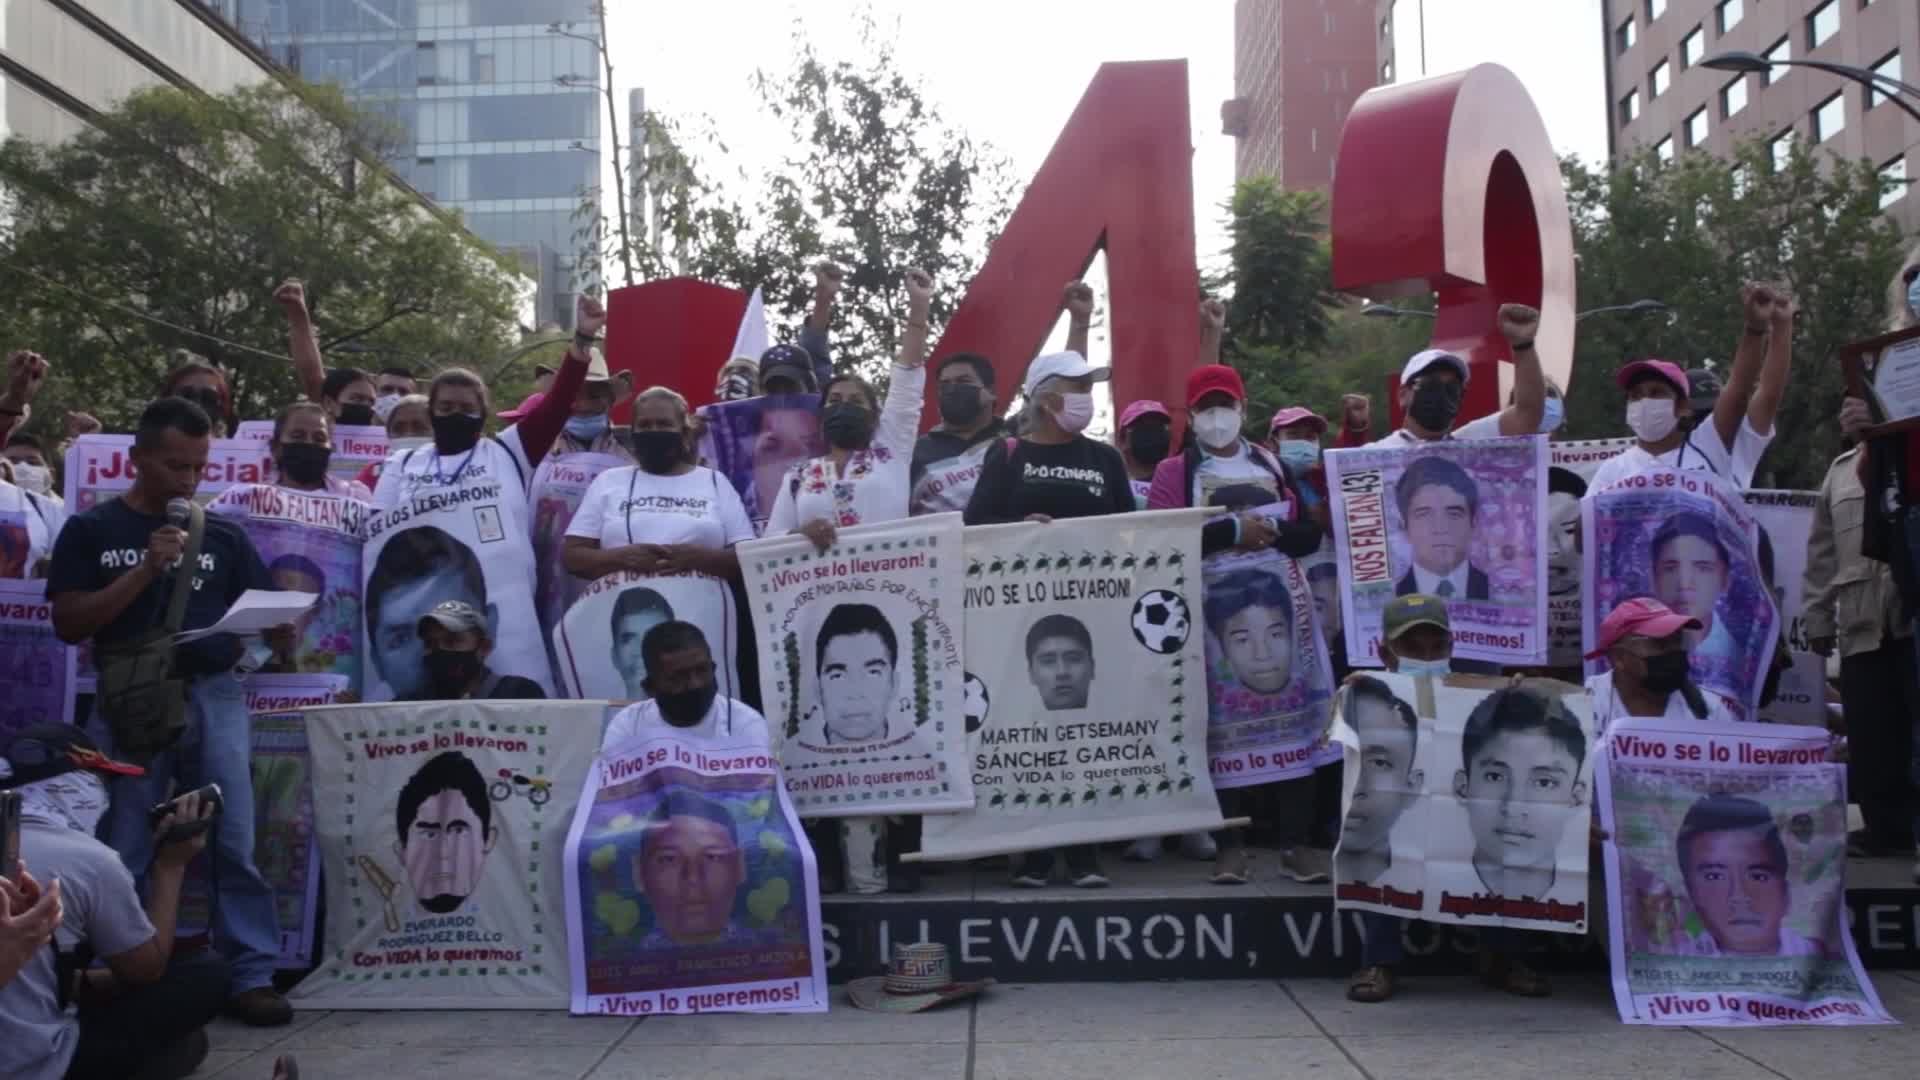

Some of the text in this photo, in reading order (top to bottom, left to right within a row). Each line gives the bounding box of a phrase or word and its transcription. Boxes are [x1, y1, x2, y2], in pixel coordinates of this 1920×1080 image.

[250, 487, 283, 515] NOS
[286, 495, 341, 527] FALTAN
[385, 506, 410, 529] LOS
[1349, 493, 1384, 549] FALTAN
[772, 552, 926, 593] ¡Vivo se lo llevaron!
[1355, 550, 1386, 582] NOS
[1002, 583, 1020, 605] SE
[1026, 581, 1047, 603] LO
[1052, 577, 1131, 601] LLEVARON!
[1449, 629, 1525, 649] ueremos!
[365, 731, 528, 759] Vivo se lo llevaron
[980, 720, 1160, 745] MARTÍN GETSEMANY
[647, 747, 667, 766] se
[675, 744, 691, 763] lo
[975, 738, 1157, 770] SÁNCHEZ GARCÍA
[1248, 752, 1266, 769] lo
[1612, 734, 1666, 760] ¡Vivo
[1674, 742, 1701, 760] se
[1709, 740, 1730, 762] lo
[786, 766, 936, 792] Con VIDA lo queremos!
[971, 762, 1167, 785] Con VIDA lo queremos!
[456, 930, 503, 943] BELLO
[352, 947, 523, 968] Con VIDA lo queremos
[600, 981, 800, 1014] ¡Vivo lo queremos!
[1649, 995, 1711, 1020] ¡Vivo
[1718, 994, 1739, 1011] lo
